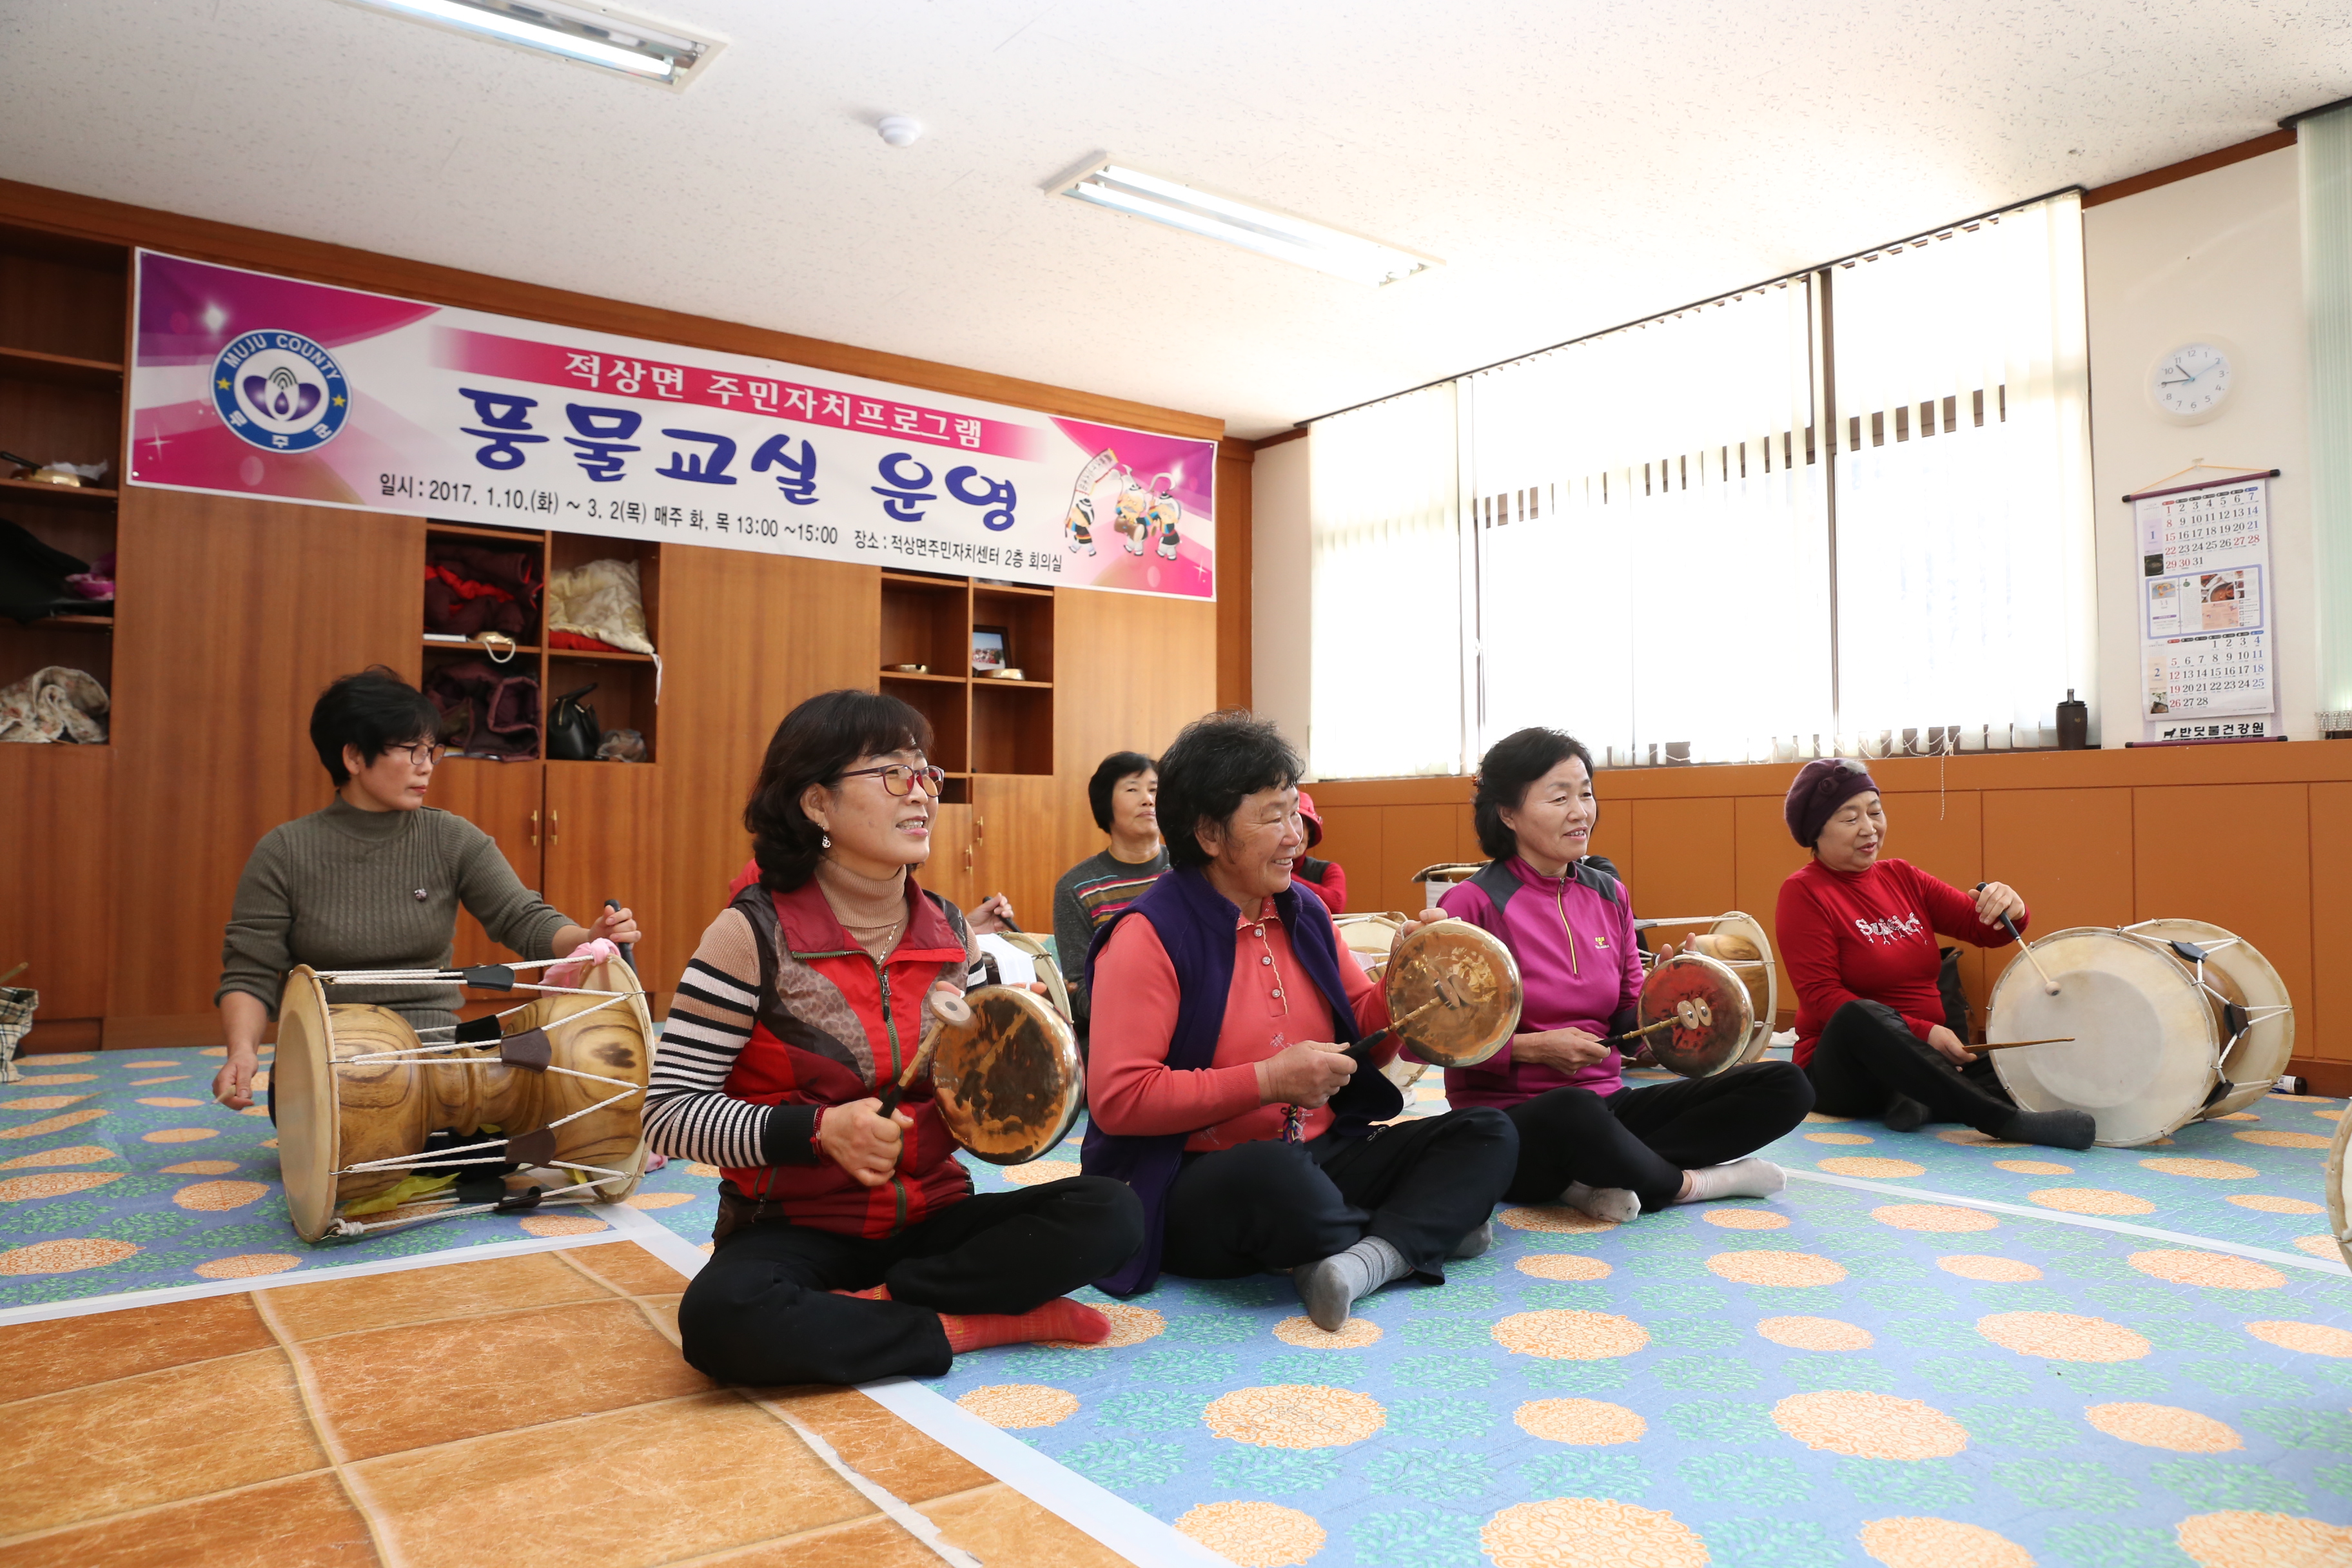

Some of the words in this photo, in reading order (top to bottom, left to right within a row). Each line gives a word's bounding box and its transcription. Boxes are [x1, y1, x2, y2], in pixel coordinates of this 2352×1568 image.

[223, 334, 267, 368] MUJU
[276, 335, 340, 379] COUNTY
[565, 352, 684, 400] 적상면
[707, 373, 982, 448] 주민자치프로그램
[459, 387, 820, 505] 풍물교실
[870, 452, 1017, 532] 운영
[654, 506, 682, 527] 매주
[716, 513, 729, 533] 목
[738, 516, 778, 537] 13:00
[2233, 509, 2244, 517] 13
[2248, 506, 2258, 514] 14
[2165, 533, 2175, 542] 15
[2192, 529, 2202, 537] 17
[2206, 527, 2217, 536] 18
[2233, 523, 2244, 531] 20
[2248, 521, 2258, 529] 21
[891, 534, 999, 565] 적상면주민자치센터
[1005, 549, 1023, 568] 2층
[1029, 553, 1062, 573] 회의실
[2179, 545, 2190, 553] 23
[2192, 543, 2203, 551] 24
[2206, 541, 2217, 549] 25
[2220, 539, 2231, 547] 26
[2233, 537, 2245, 545] 27
[2248, 534, 2260, 544] 28
[2253, 650, 2262, 658] 11
[2211, 668, 2221, 676] 15
[2224, 667, 2235, 675] 16
[2253, 664, 2264, 672] 18
[2210, 682, 2221, 691] 22
[2238, 680, 2249, 688] 24
[2253, 678, 2264, 687] 25
[2180, 722, 2264, 737] 반딧불건강원
